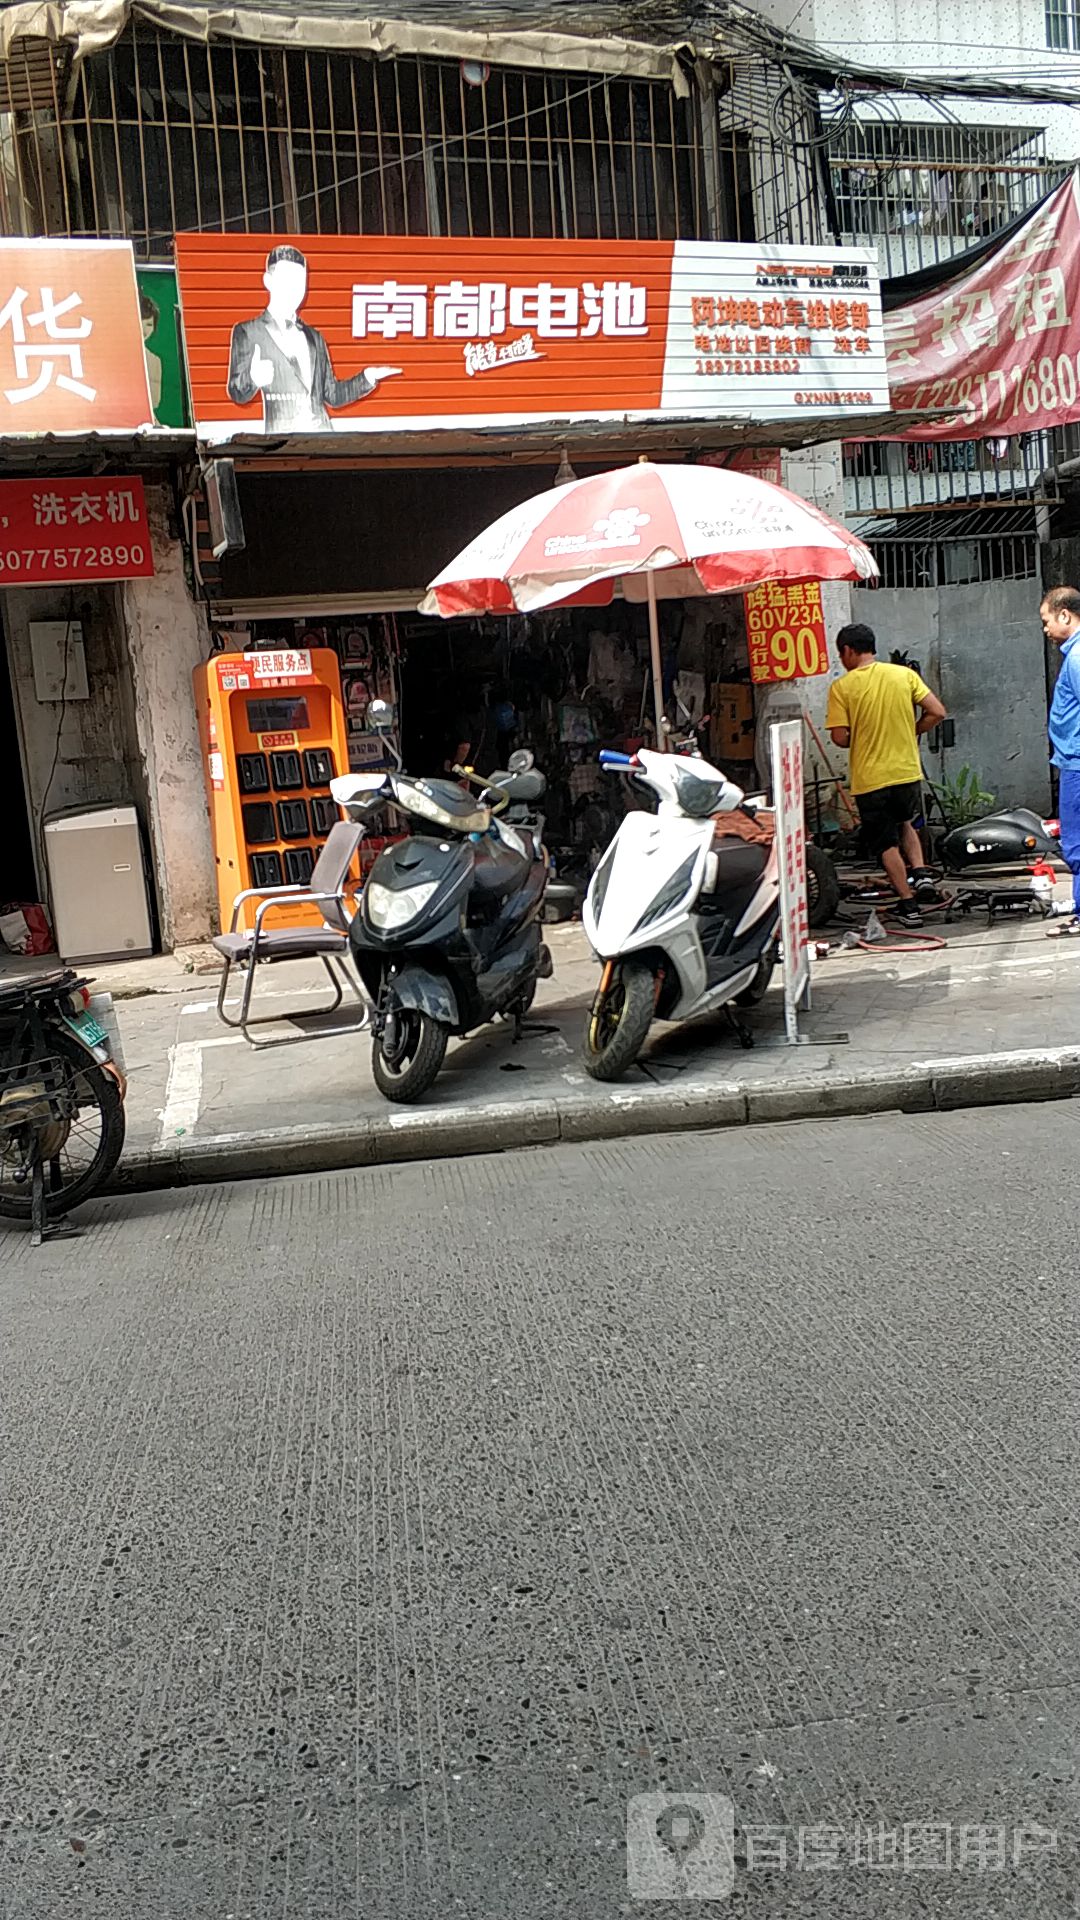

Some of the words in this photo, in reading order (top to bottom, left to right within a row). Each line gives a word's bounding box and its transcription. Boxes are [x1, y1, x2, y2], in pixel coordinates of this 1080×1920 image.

[352, 280, 649, 338] 南都电池
[690, 296, 871, 331] 阿坤电动车维修部
[0, 286, 97, 404] 货
[833, 336, 872, 354] 洗车
[748, 604, 823, 630] 60V23A
[770, 627, 819, 678] 90
